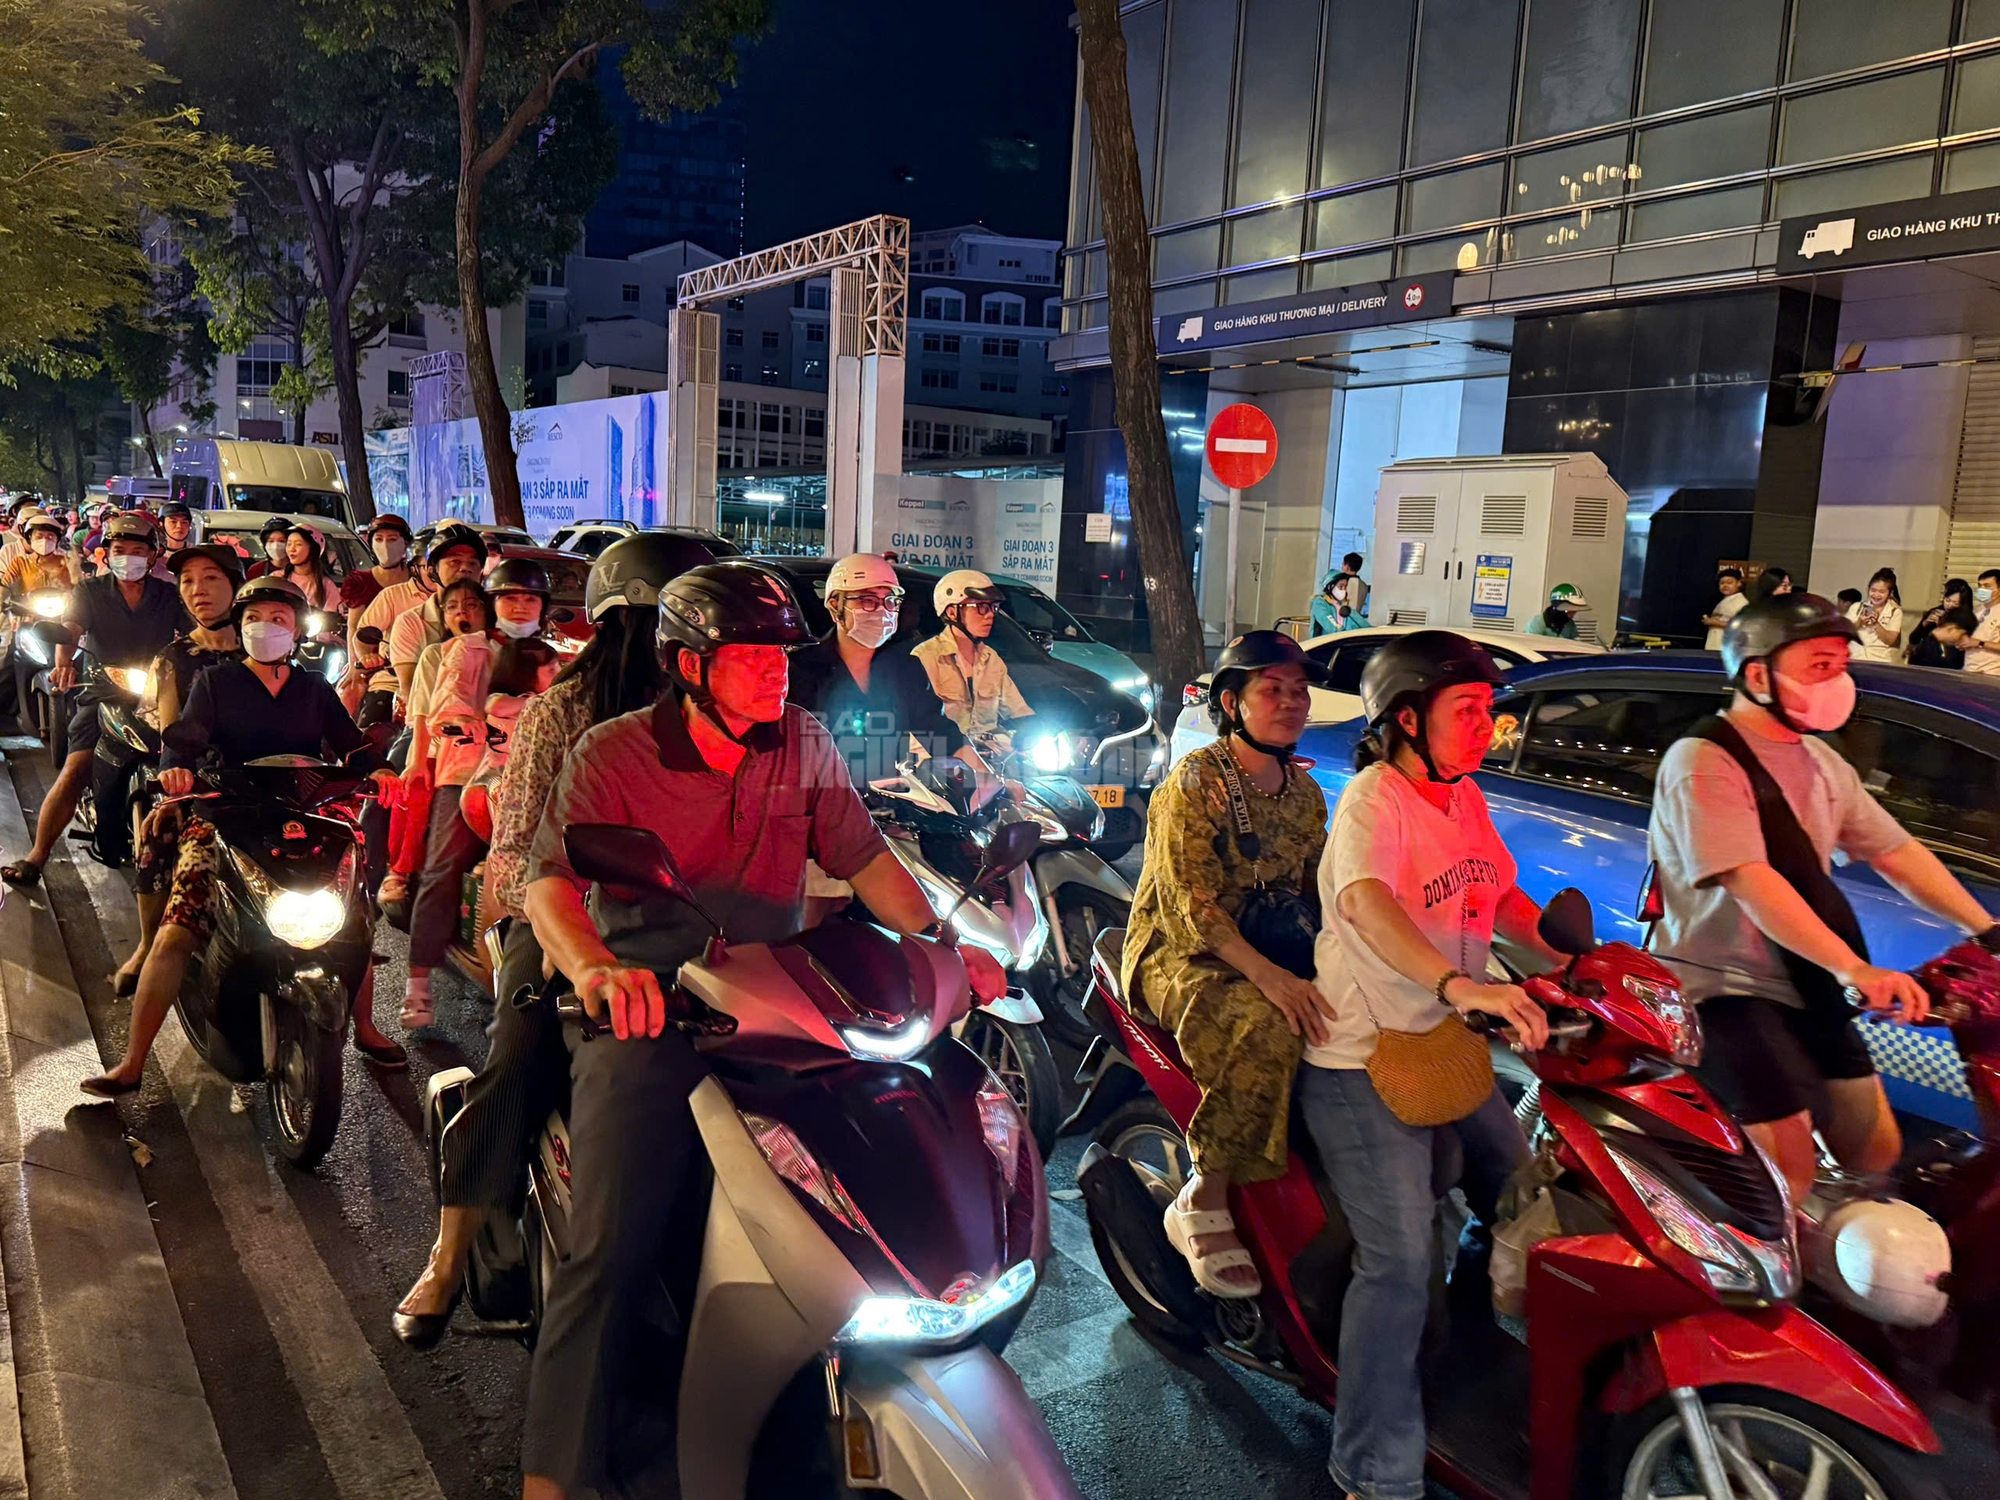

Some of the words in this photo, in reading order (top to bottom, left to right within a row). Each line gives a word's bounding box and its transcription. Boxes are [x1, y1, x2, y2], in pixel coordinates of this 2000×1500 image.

[1866, 226, 1902, 241] GIAO
[1905, 221, 1946, 236] HÀNG
[1950, 215, 1982, 230] KHU
[1214, 319, 1234, 331] GIAO
[1235, 313, 1258, 328] HÀNG
[1259, 310, 1278, 324] KHU
[1279, 305, 1317, 321] THƯƠNG
[1318, 303, 1335, 317] MẠI
[1341, 296, 1388, 313] DELIVERY
[311, 431, 339, 445] ASU
[533, 481, 538, 499] 3
[540, 475, 555, 499] SẮP
[557, 481, 569, 499] RA
[570, 474, 589, 499] MẮT
[899, 499, 924, 508] Keppel
[557, 506, 575, 520] SOON
[892, 533, 919, 547] GIAI
[924, 534, 962, 552] ĐOẠN
[966, 536, 973, 549] 3
[1004, 540, 1020, 552] GIAI
[1022, 541, 1046, 555] ĐOẠN
[1048, 542, 1054, 553] 3
[923, 554, 941, 566] RA
[1002, 554, 1019, 568] SẮP
[1020, 558, 1033, 569] RA
[1087, 789, 1117, 804] 7.18
